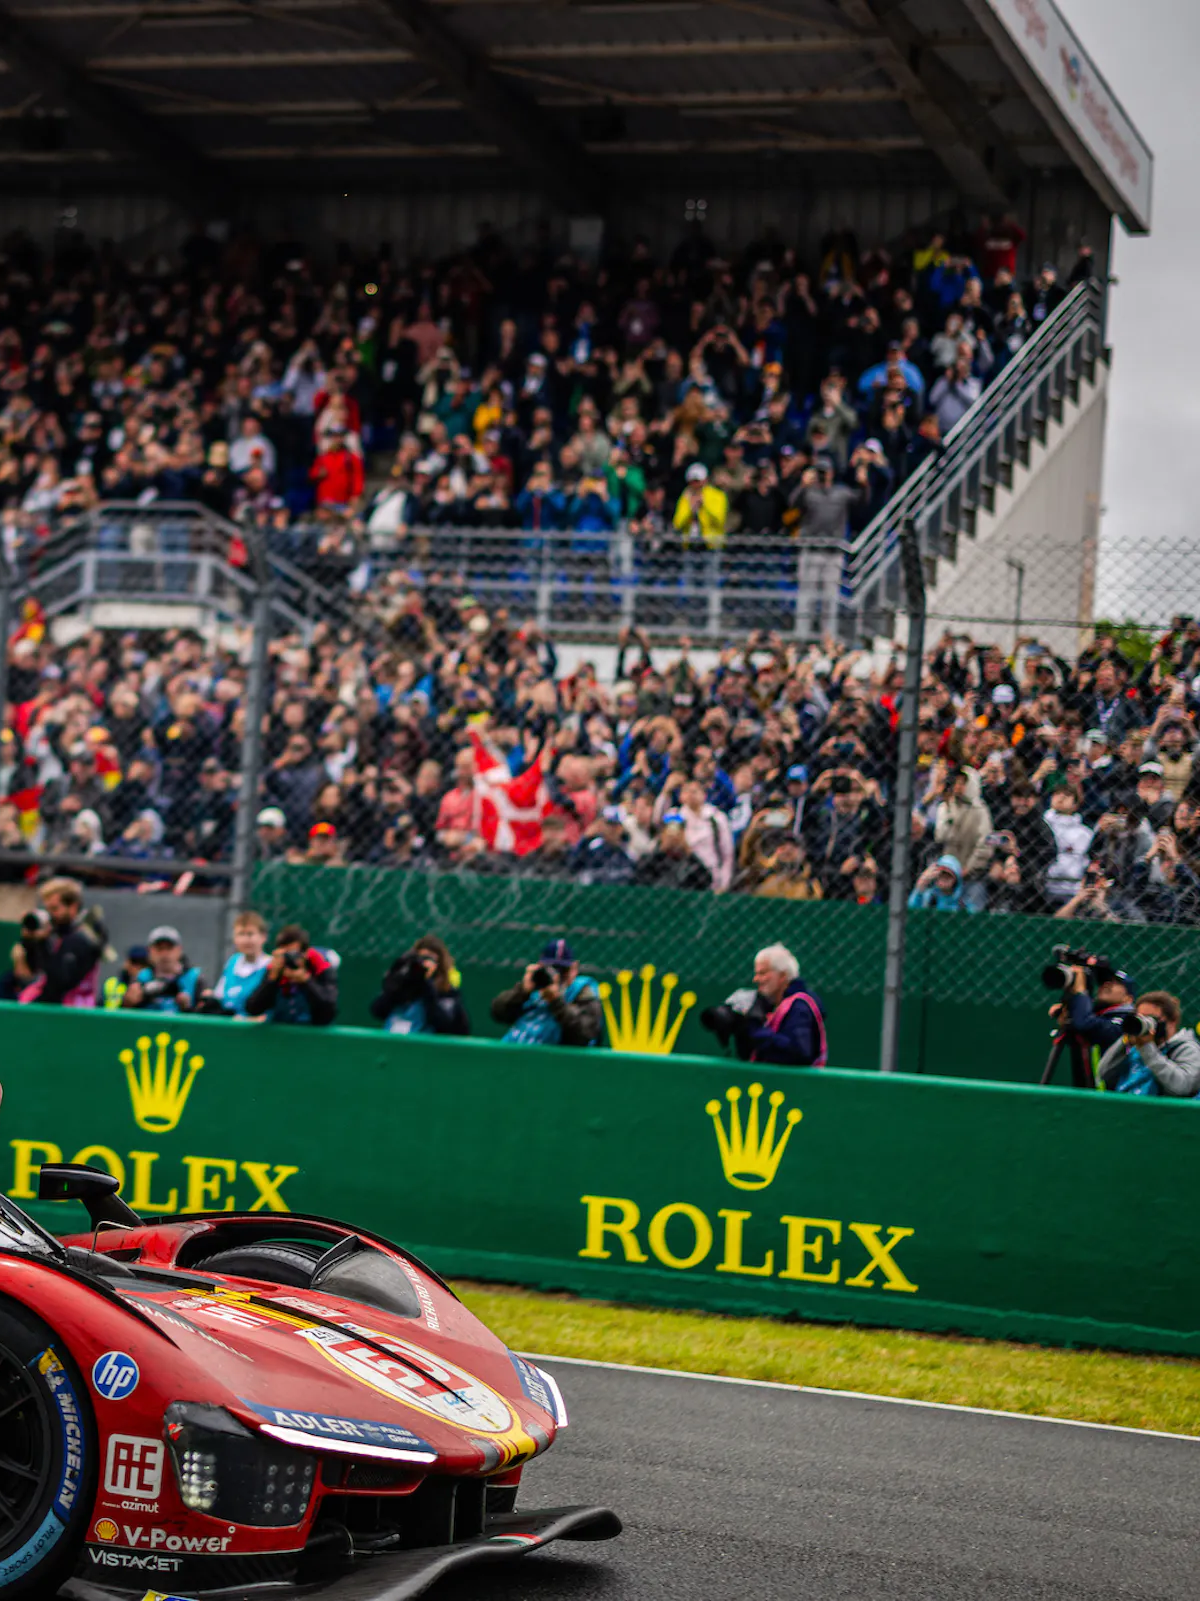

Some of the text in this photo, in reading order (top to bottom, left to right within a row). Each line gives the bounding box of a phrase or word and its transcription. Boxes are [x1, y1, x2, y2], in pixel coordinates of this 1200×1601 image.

[7, 1139, 299, 1213] ROLEX
[578, 1195, 918, 1293] ROLEX
[416, 1284, 440, 1331] RICHARD
[98, 1353, 135, 1399] hp
[272, 1411, 364, 1437] ADLER
[57, 1392, 82, 1510] MICHELIN
[121, 1498, 160, 1513] azimut
[3, 1524, 55, 1577] PILOT SPORT
[123, 1525, 233, 1552] V-Power
